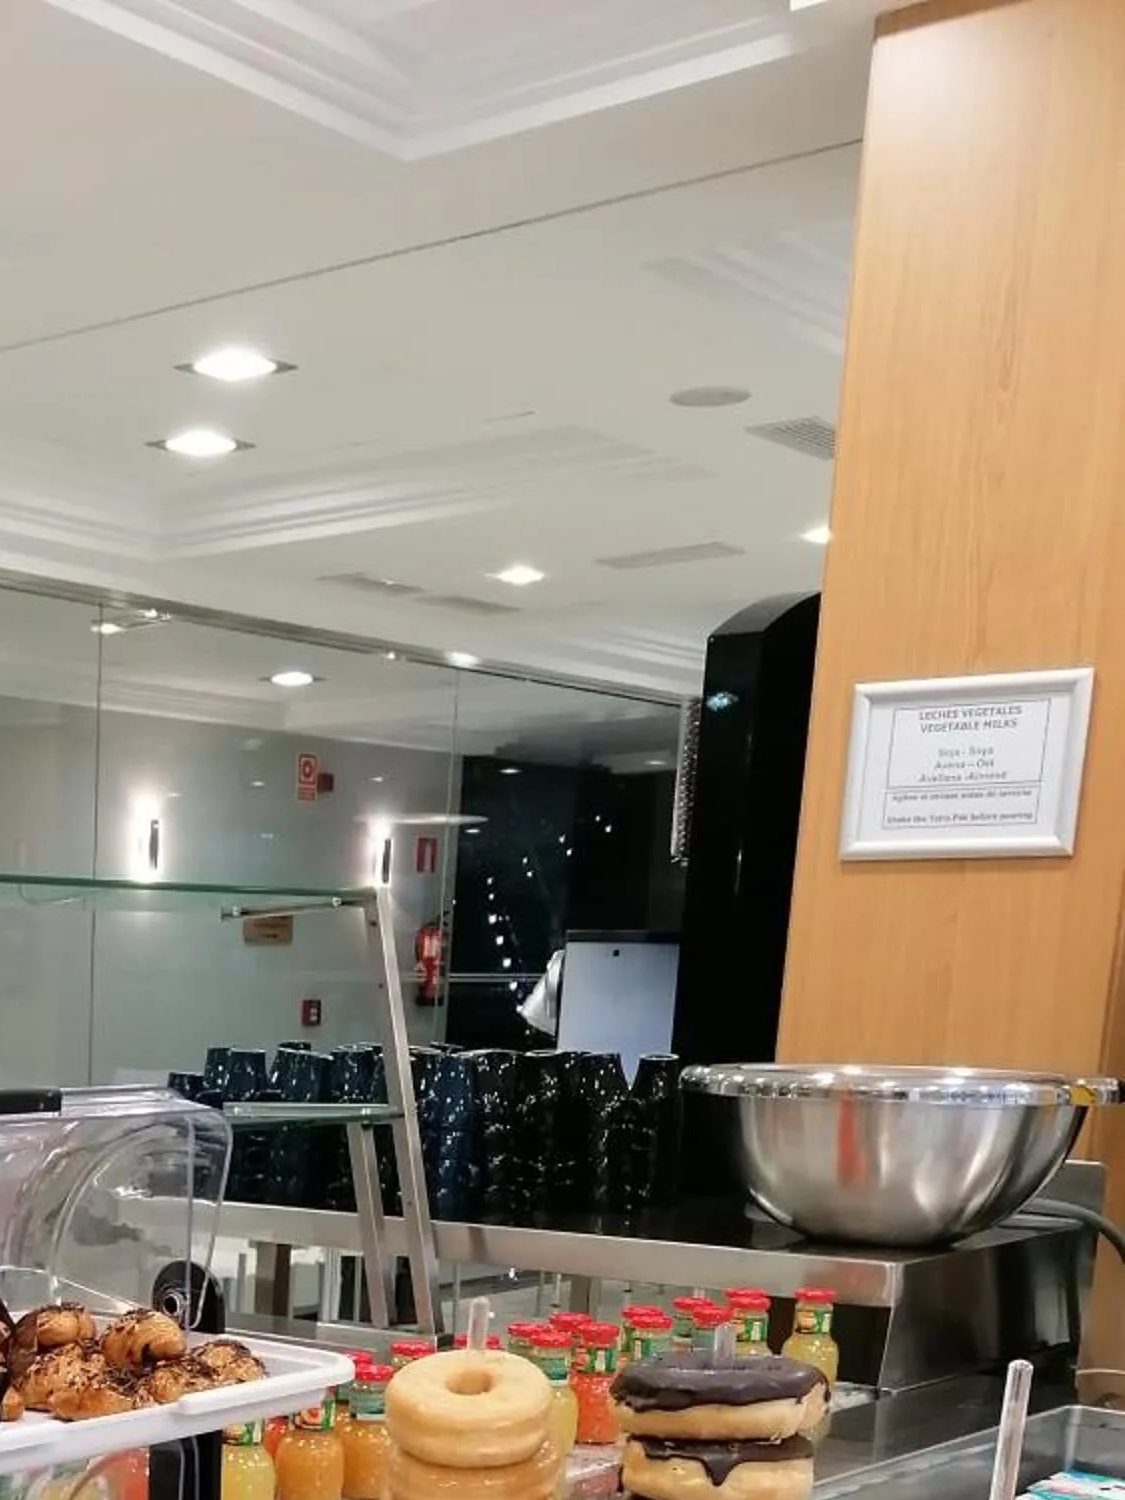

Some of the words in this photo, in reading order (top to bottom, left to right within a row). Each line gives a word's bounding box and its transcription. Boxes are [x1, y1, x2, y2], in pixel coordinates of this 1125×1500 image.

[919, 710, 958, 720] LECHES
[960, 705, 1023, 718] VEGETALES
[920, 720, 979, 733] VEGETABLE
[983, 718, 1018, 729] MILKS
